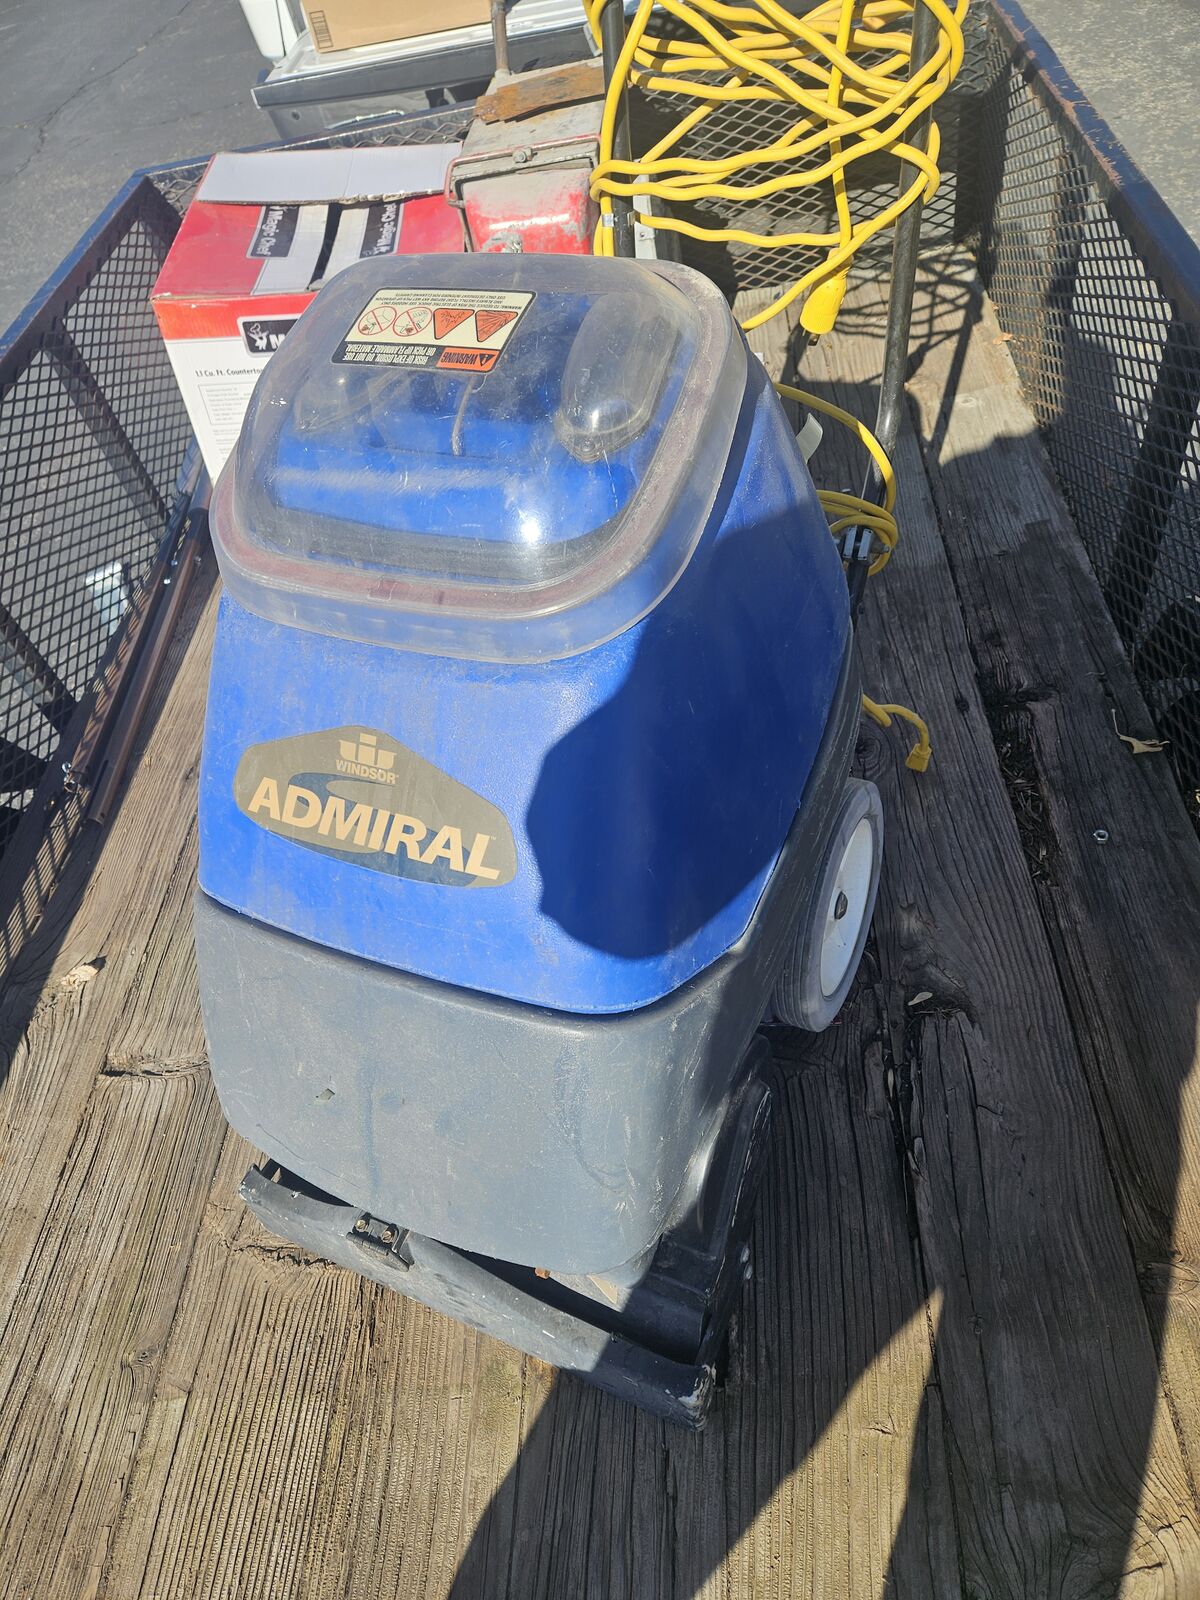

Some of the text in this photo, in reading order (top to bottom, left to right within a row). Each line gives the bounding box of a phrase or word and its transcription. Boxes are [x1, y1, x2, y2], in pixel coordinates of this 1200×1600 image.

[256, 210, 284, 255] Magic Chef
[376, 222, 396, 246] Magic
[371, 345, 405, 354] FLAMMABLE
[405, 346, 413, 355] UP
[414, 347, 428, 355] PICK
[428, 348, 436, 356] OR
[343, 352, 354, 360] USE
[354, 353, 367, 361] NOT
[368, 353, 375, 362] DO
[406, 355, 413, 364] OF
[413, 355, 428, 365] RISK
[440, 352, 478, 365] WARNING
[336, 759, 396, 785] WINDSOR
[248, 776, 500, 880] ADMIRAL
